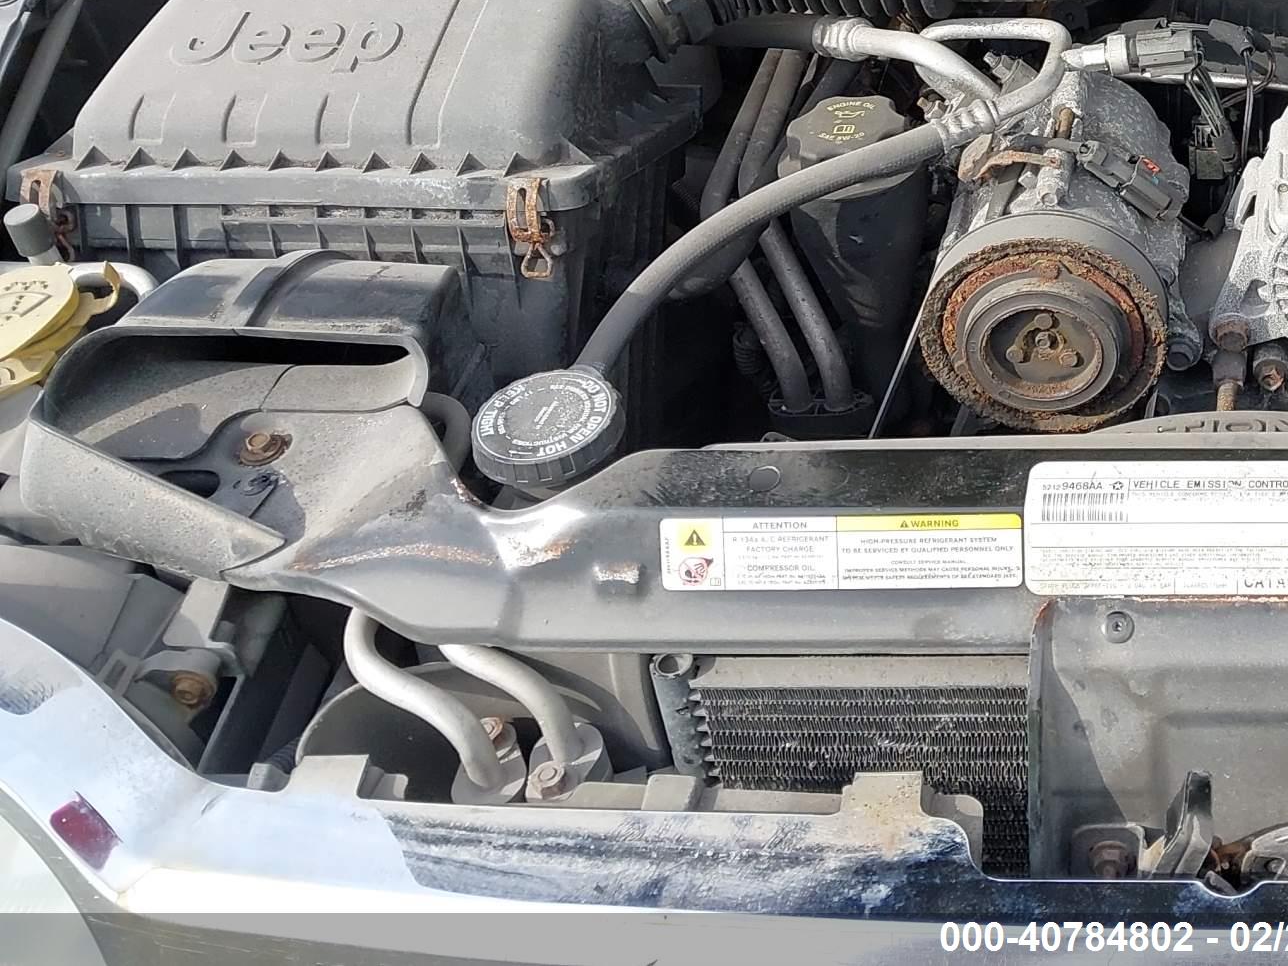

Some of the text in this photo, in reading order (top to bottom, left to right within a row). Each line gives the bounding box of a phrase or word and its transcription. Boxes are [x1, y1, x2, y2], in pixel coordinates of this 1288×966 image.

[169, 11, 405, 74] Jeep
[826, 101, 876, 111] ENGINE OIL
[581, 380, 599, 394] DO
[494, 384, 528, 408] KEEP
[594, 393, 609, 413] NOT
[481, 409, 498, 436] TIGHT
[569, 416, 603, 443] OPEN
[536, 443, 568, 457] HOT
[1133, 480, 1181, 489] VEHICLE
[1186, 480, 1242, 489] EMISSION
[753, 521, 808, 530] ATTENTION
[910, 519, 960, 528] WARNING
[746, 545, 780, 553] FACTORY
[951, 545, 993, 553] PERSONNEL
[747, 564, 800, 572] COMPRESSOR
